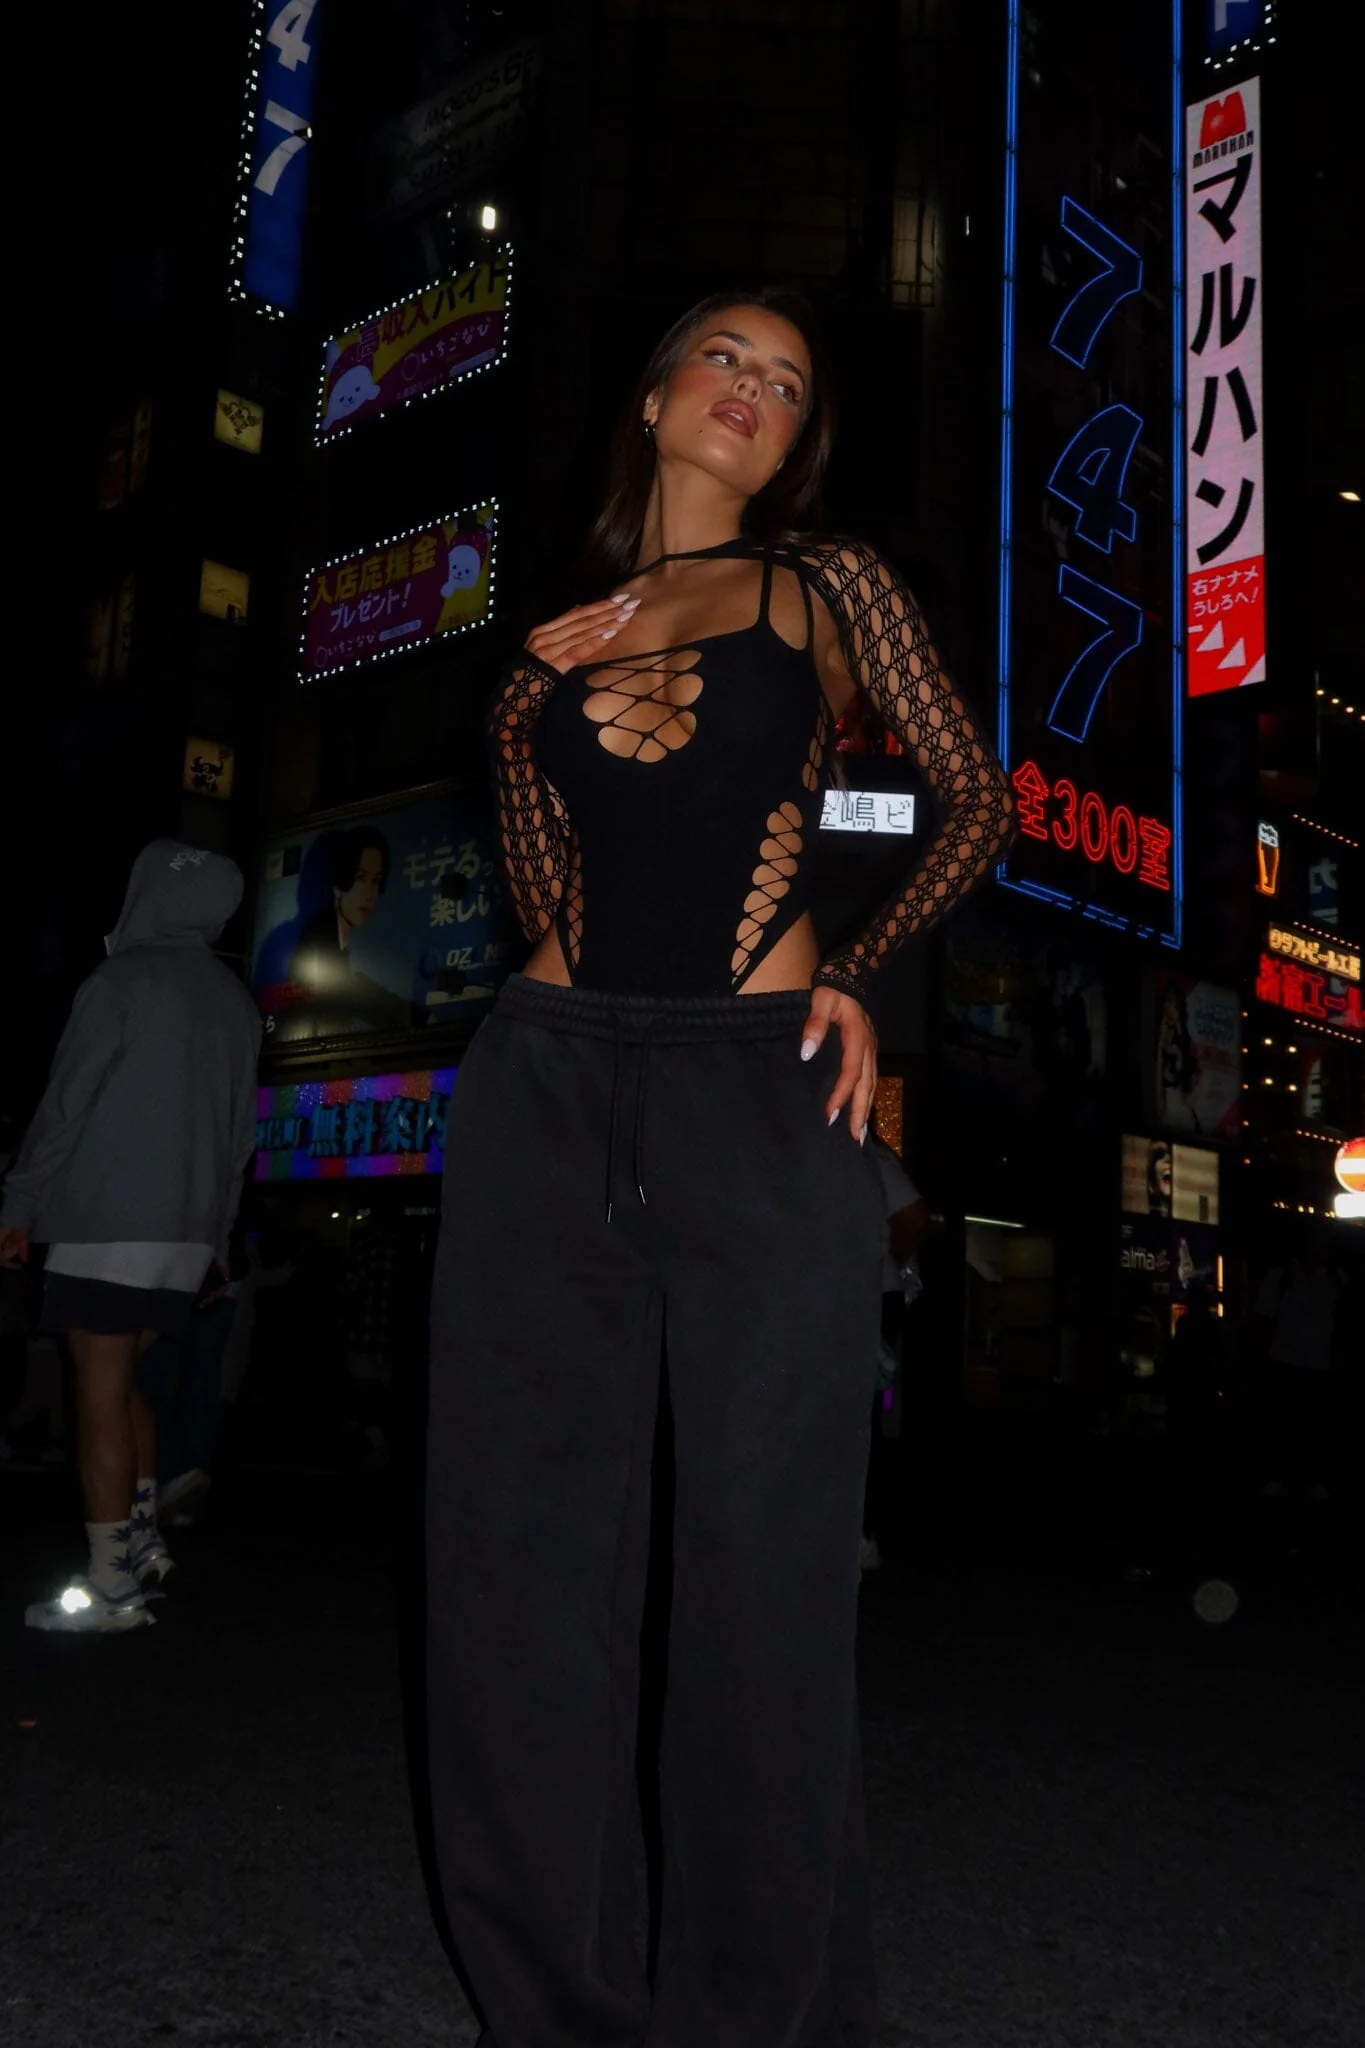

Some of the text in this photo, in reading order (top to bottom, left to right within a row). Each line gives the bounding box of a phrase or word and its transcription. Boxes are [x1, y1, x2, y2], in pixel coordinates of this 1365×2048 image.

[1193, 131, 1254, 169] MARUHAN
[1190, 152, 1256, 565] マルハン
[1045, 193, 1144, 745] 747
[1191, 564, 1260, 597] 右ナナメ
[1012, 760, 1172, 892] 全300室
